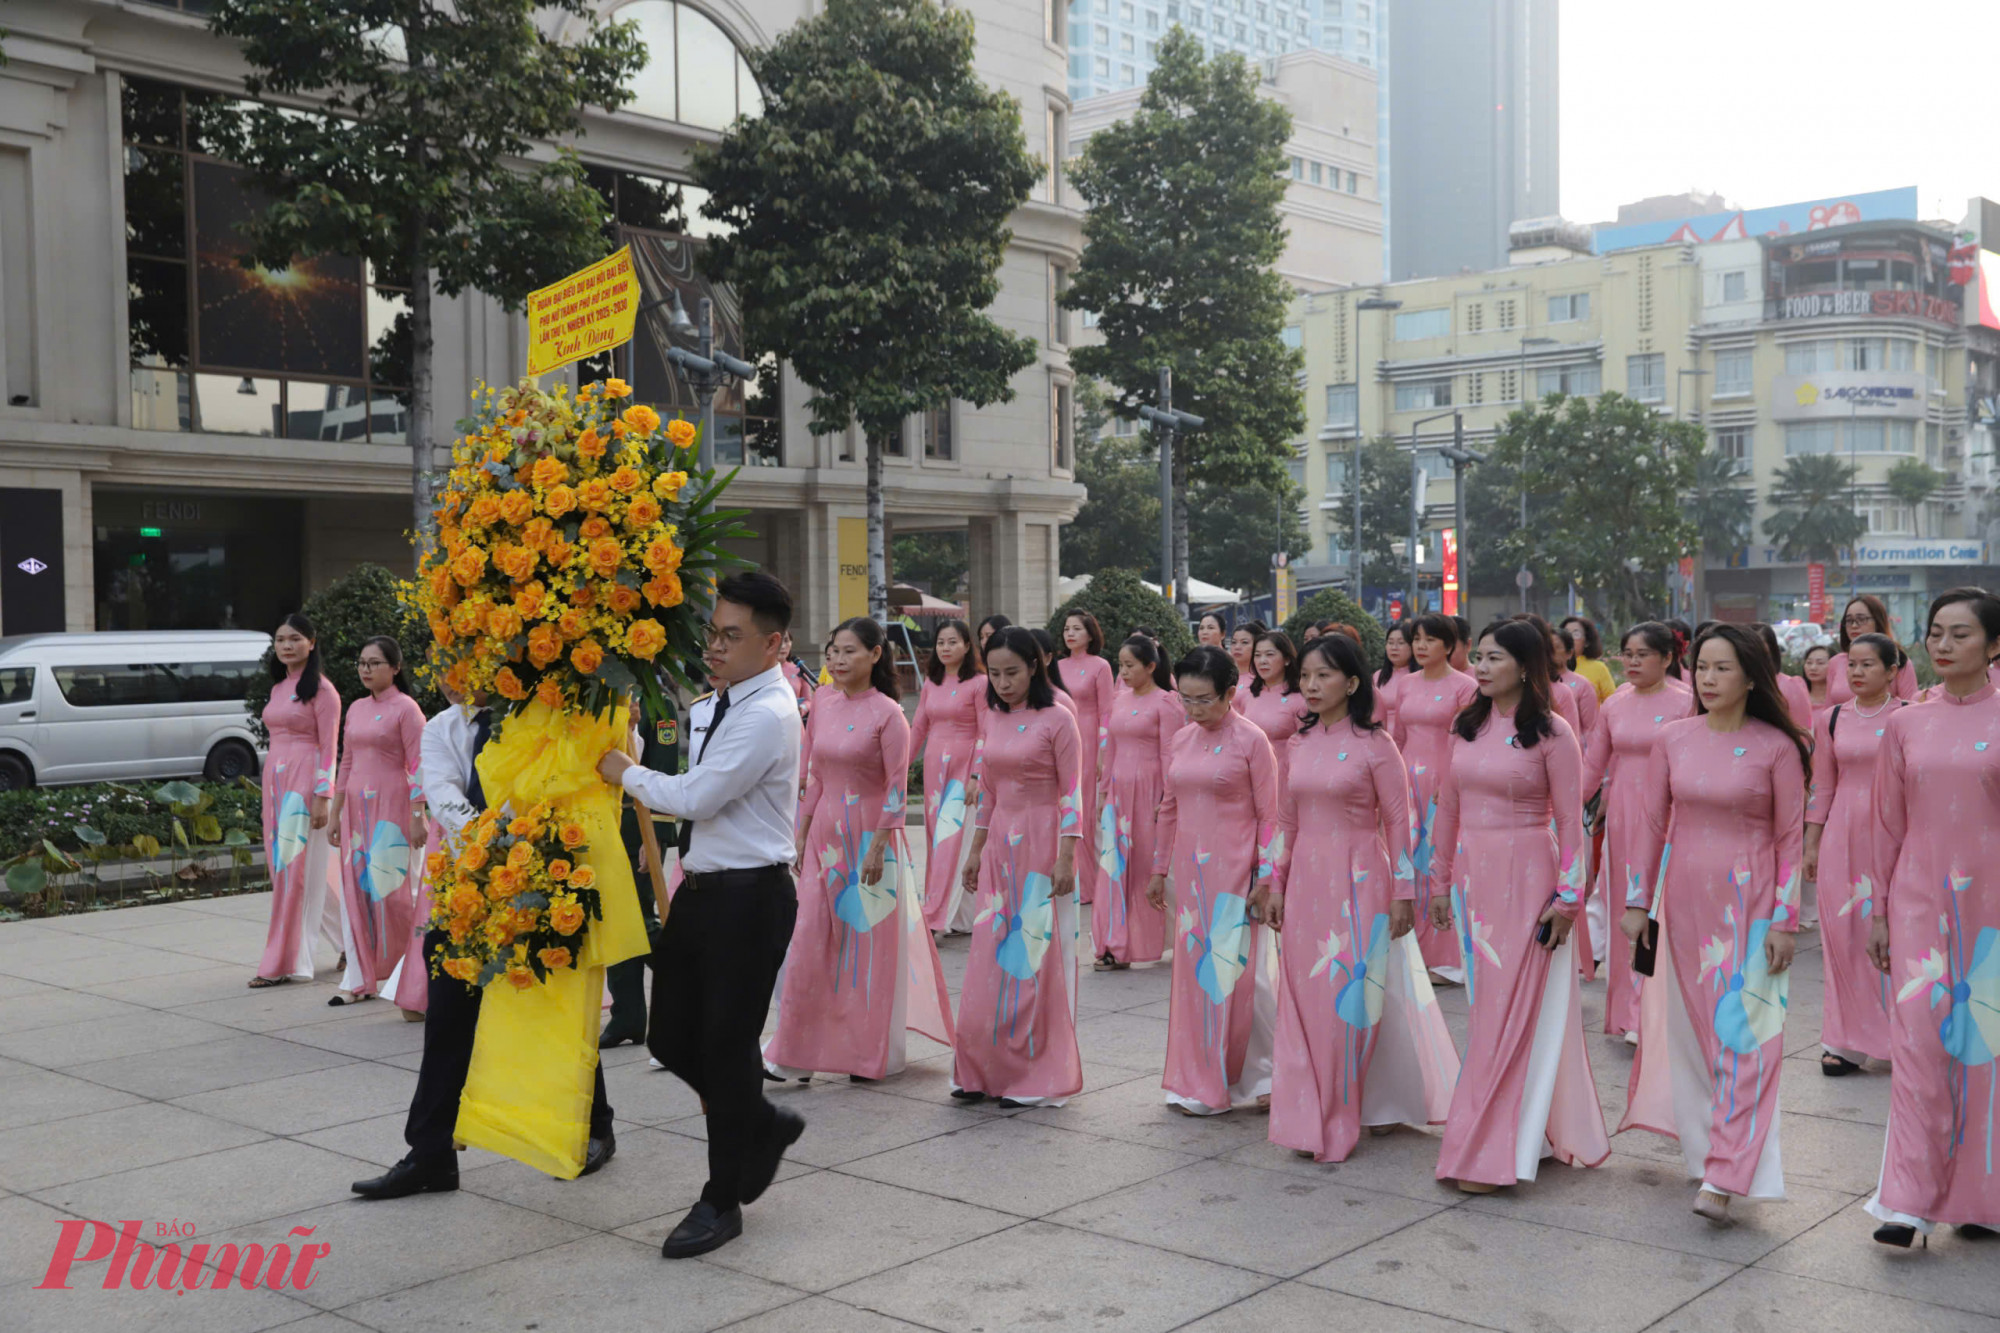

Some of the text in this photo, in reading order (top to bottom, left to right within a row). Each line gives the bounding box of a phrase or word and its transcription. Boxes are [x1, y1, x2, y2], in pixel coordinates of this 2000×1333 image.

[612, 280, 628, 297] MINH
[1785, 293, 1820, 319] FOOD
[1822, 297, 1833, 314] &
[1834, 291, 1870, 315] BEER
[1872, 290, 1923, 317] SKY
[567, 315, 586, 332] NHIỆM
[596, 305, 610, 321] 2025
[613, 298, 628, 314] 2030
[143, 501, 201, 520] FENDI
[840, 564, 868, 576] FENDI
